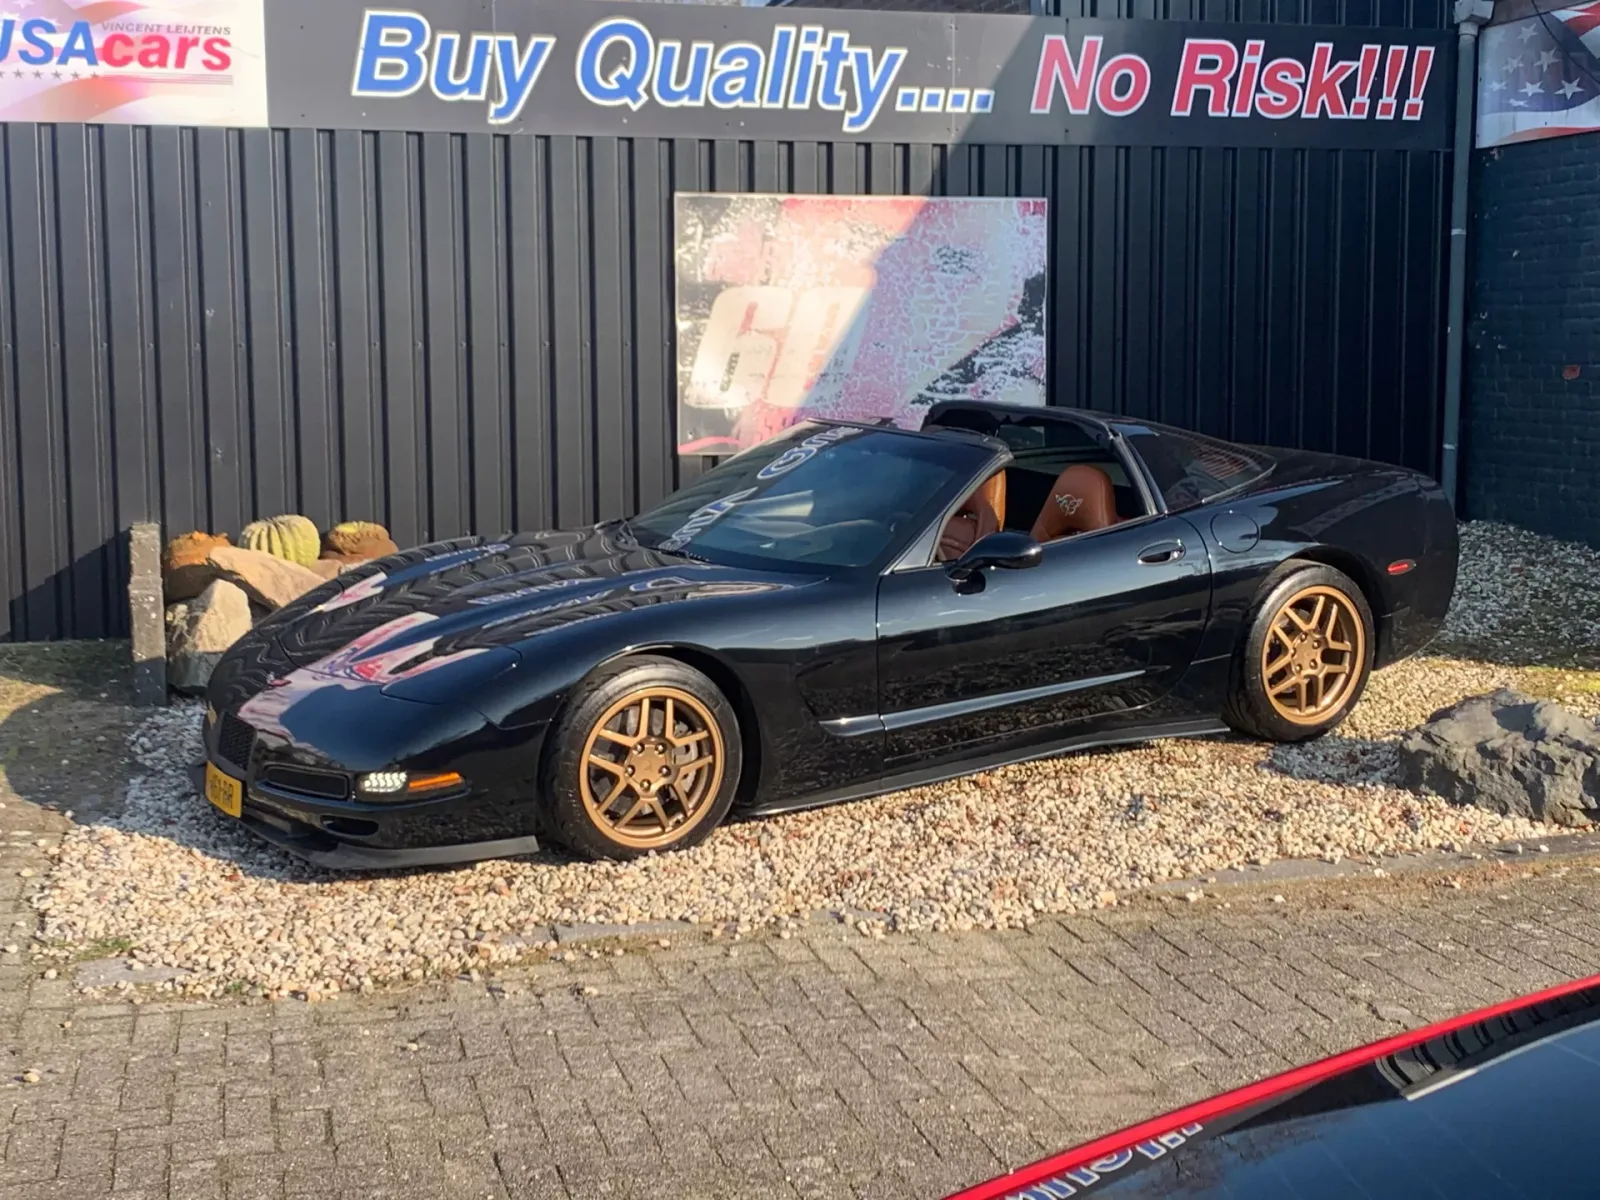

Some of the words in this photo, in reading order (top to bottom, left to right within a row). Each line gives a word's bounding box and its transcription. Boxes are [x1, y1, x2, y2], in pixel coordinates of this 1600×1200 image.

[101, 21, 163, 33] VINCENT
[166, 24, 232, 36] LEIJTENS
[350, 7, 557, 126] Buy
[1029, 34, 1151, 117] No
[1170, 37, 1436, 121] Risk!!!
